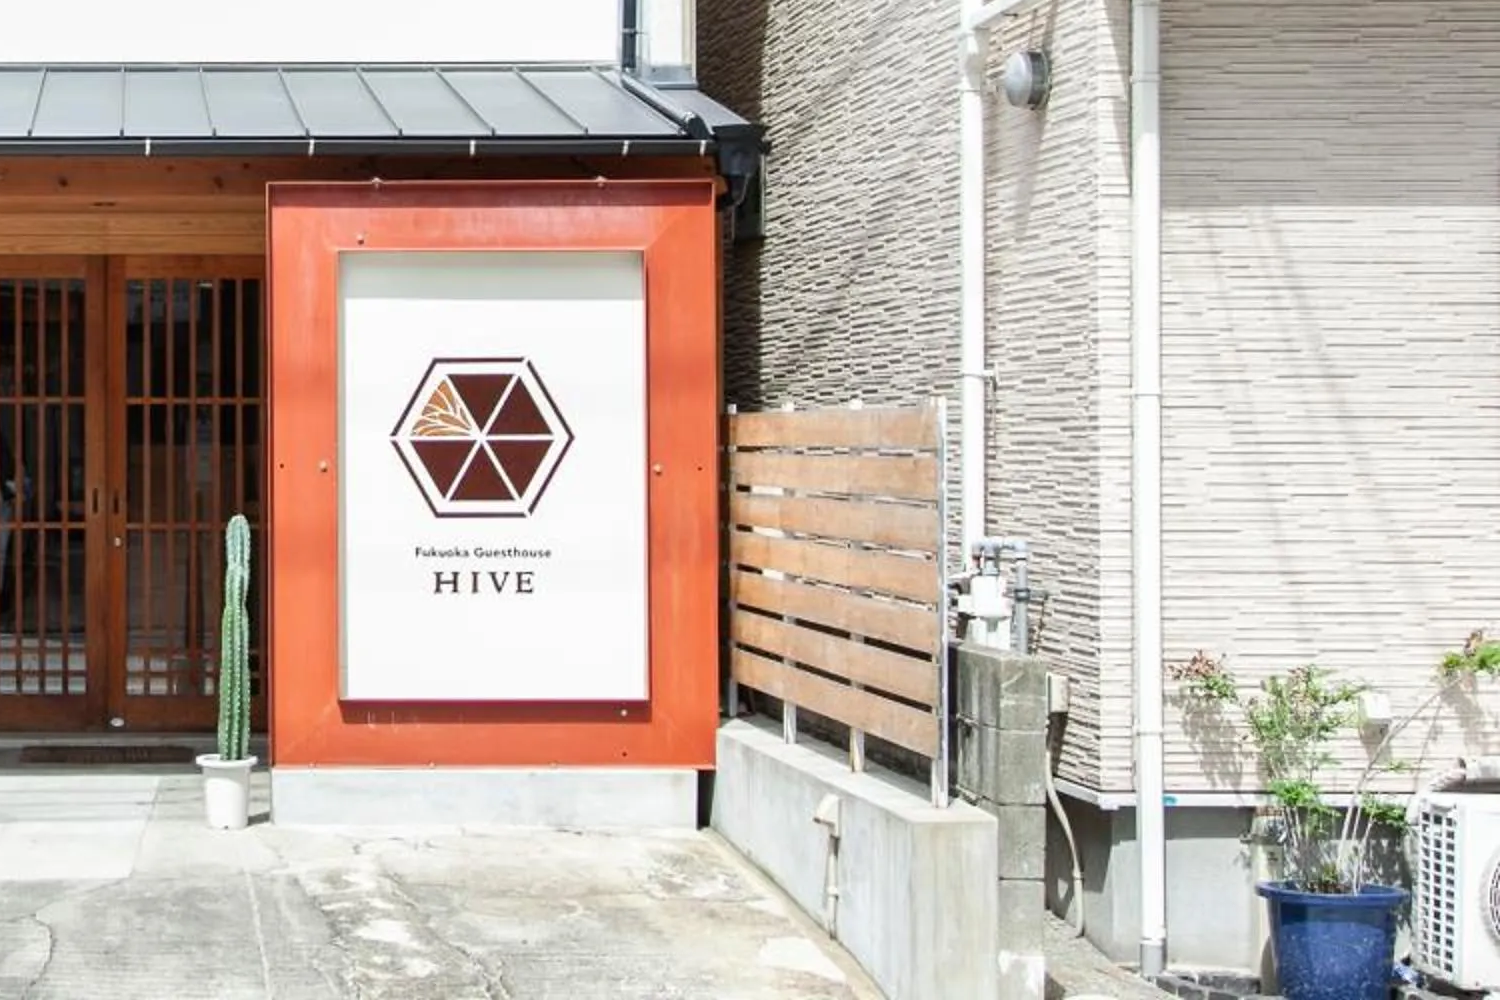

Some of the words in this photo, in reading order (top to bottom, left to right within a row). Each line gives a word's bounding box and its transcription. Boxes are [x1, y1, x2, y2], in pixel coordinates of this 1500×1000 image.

[414, 546, 470, 558] Fukuoka
[473, 546, 552, 558] Guesthouse
[433, 571, 534, 594] HIVE
